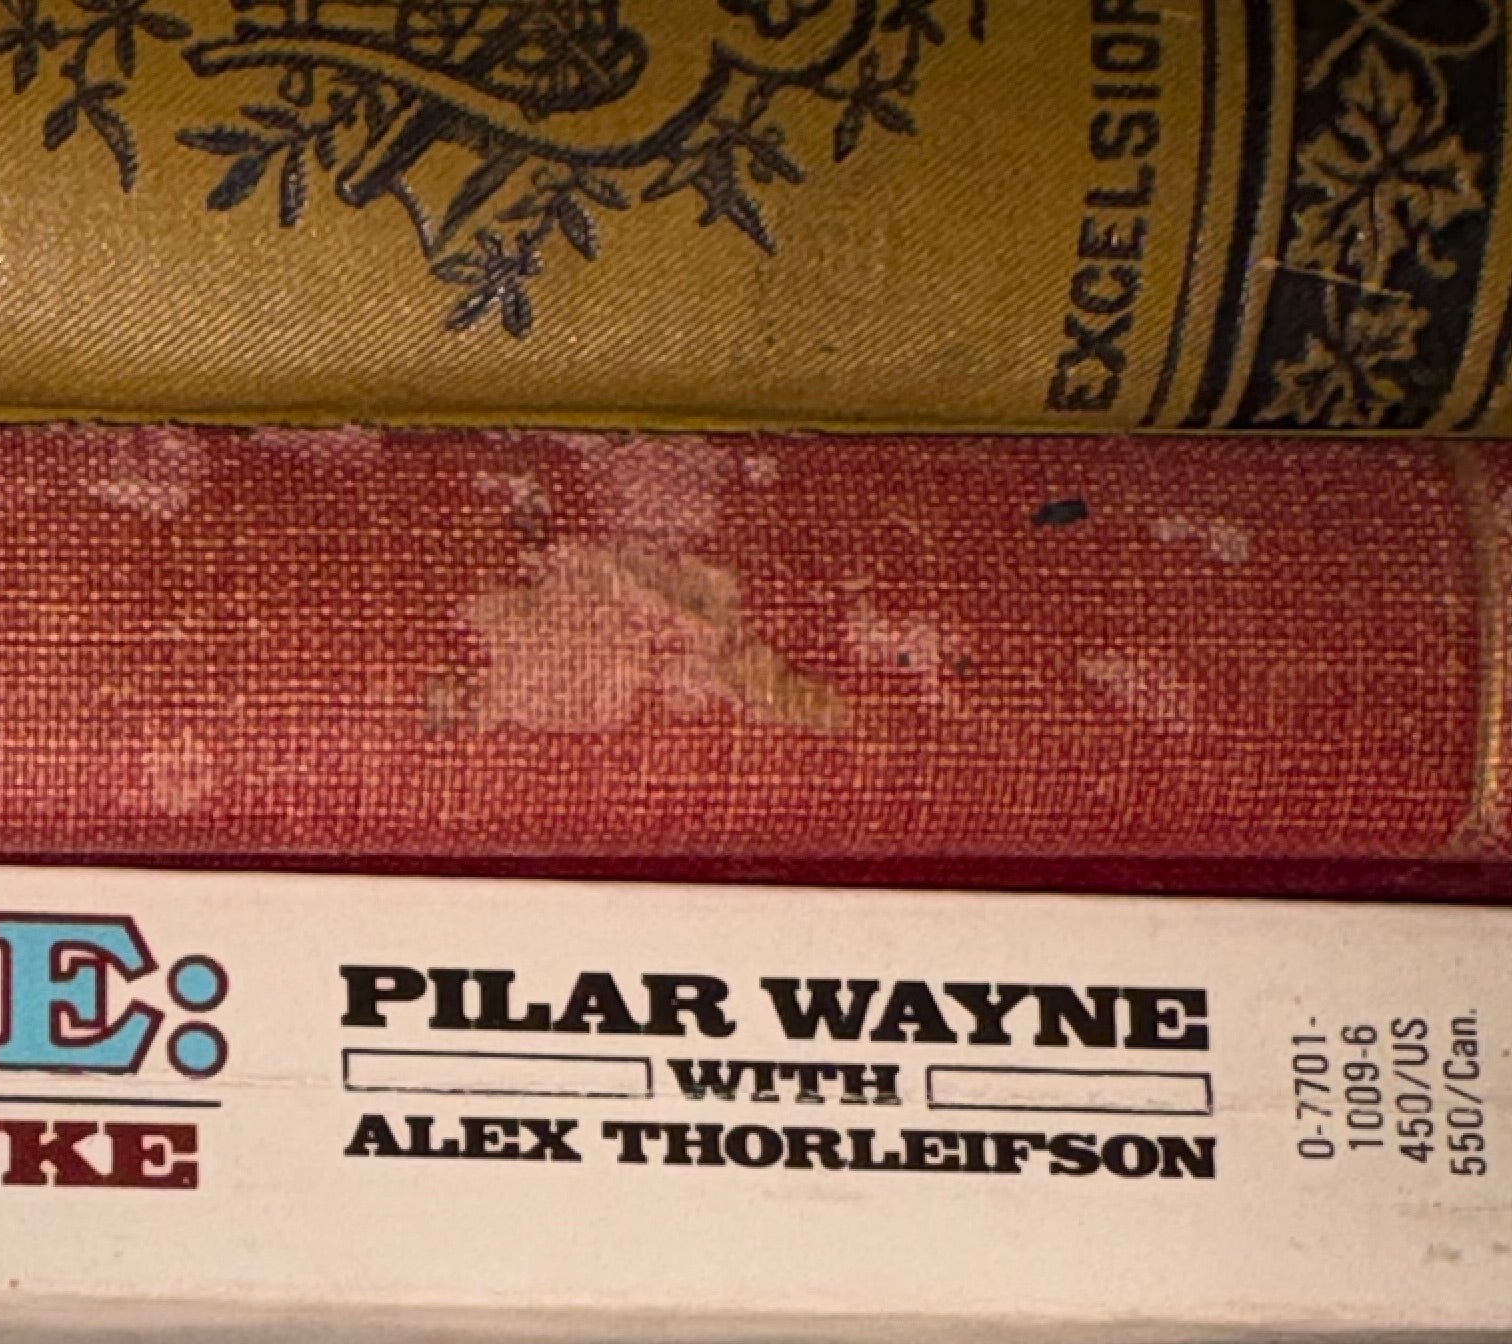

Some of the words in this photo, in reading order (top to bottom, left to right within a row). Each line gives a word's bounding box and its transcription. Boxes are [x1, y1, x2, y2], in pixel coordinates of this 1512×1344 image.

[339, 964, 735, 1040] PILAR
[760, 976, 1210, 1051] WAYNE
[667, 1056, 900, 1106] WITH
[1291, 1016, 1335, 1160] 0-7701-
[1340, 1025, 1384, 1151] 1009-6
[1390, 1017, 1434, 1163] 450/US
[1441, 1008, 1486, 1176] 550/Can.
[343, 1115, 581, 1163] ALEX
[603, 1120, 1217, 1179] THORLEIFSON
